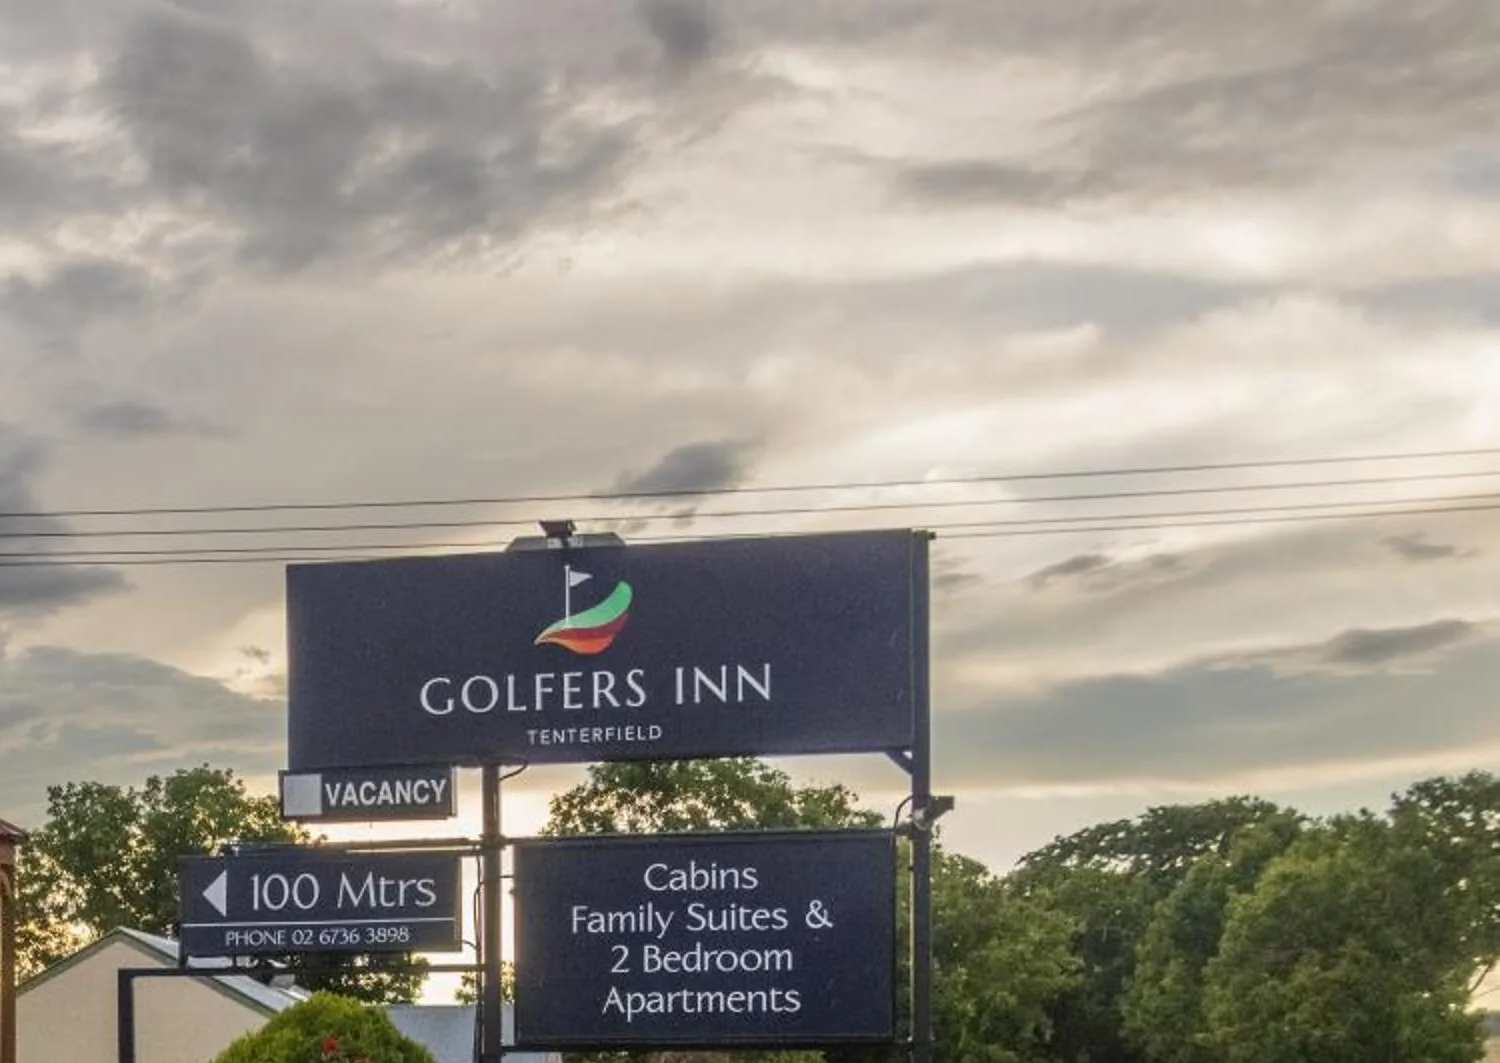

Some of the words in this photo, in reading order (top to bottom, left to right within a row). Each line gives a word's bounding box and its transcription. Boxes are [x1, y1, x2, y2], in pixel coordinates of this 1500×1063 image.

[420, 668, 647, 715] GOLFERS
[675, 663, 771, 705] INN
[527, 725, 662, 745] TENTERFIELD
[325, 779, 446, 807] VACANCY
[250, 873, 320, 911] 100
[337, 871, 437, 909] Mtrs
[644, 860, 759, 891] Cabins
[571, 901, 675, 939] Family
[686, 903, 789, 931] Suites
[805, 899, 834, 929] &
[225, 929, 286, 946] PHONE
[291, 929, 314, 945] 02
[319, 928, 361, 944] 6736
[365, 927, 410, 943] 3898
[611, 945, 630, 973] 2
[643, 942, 793, 973] Bedroom
[602, 986, 802, 1022] Apartments
